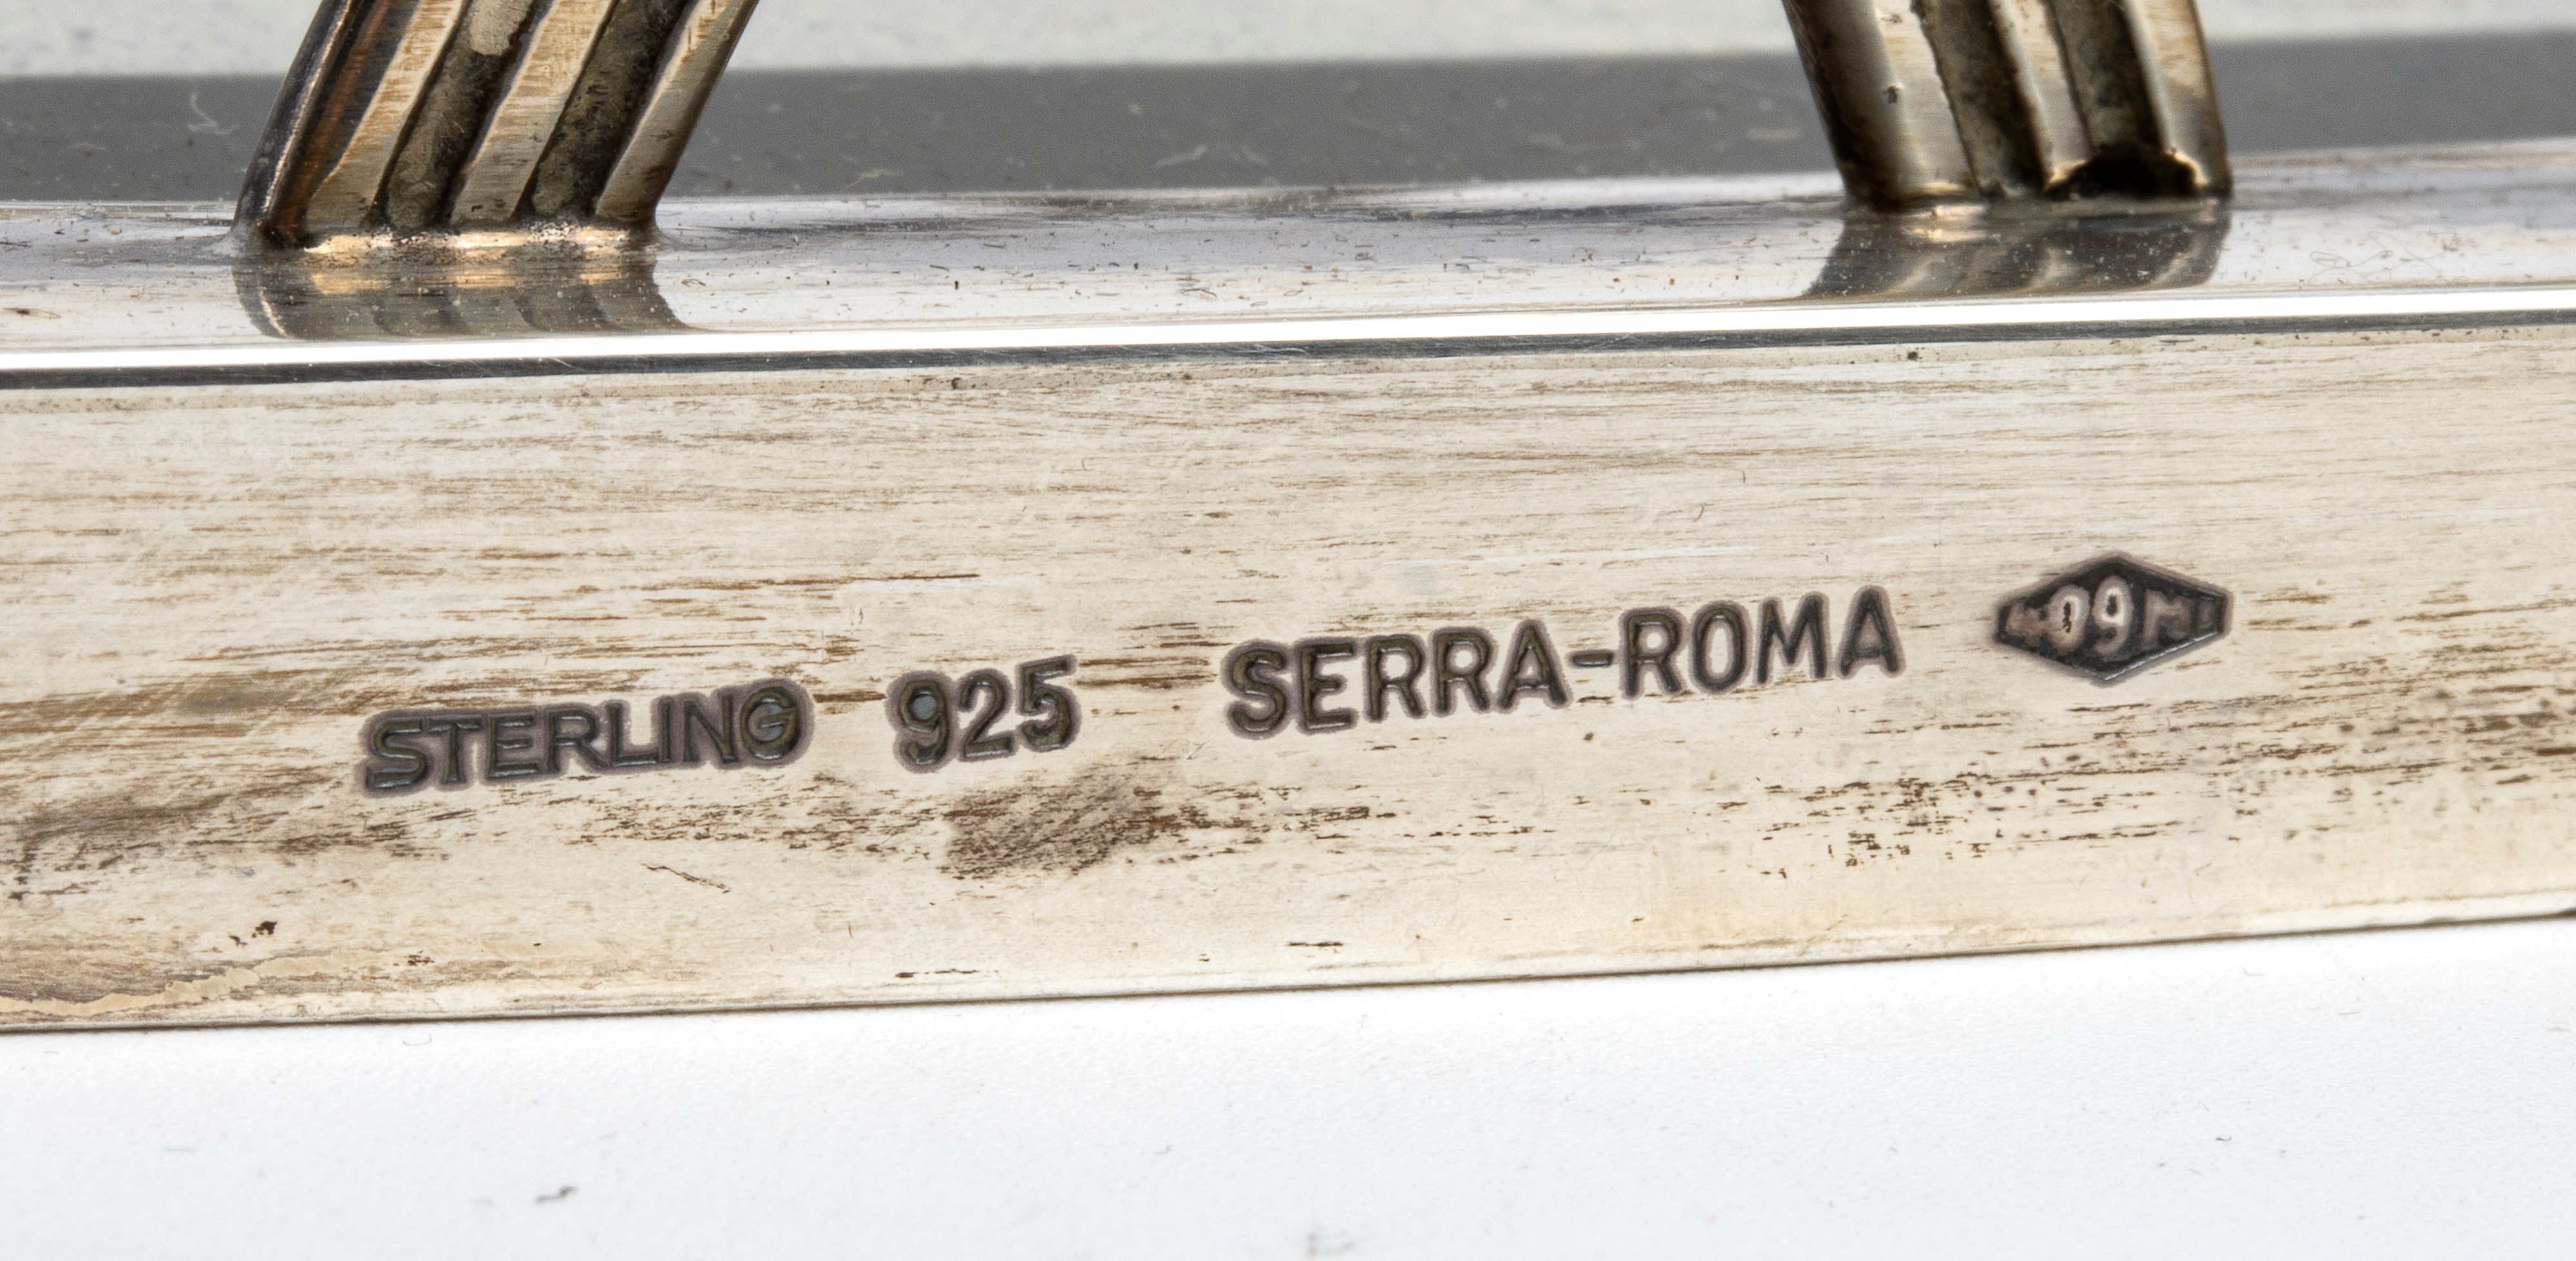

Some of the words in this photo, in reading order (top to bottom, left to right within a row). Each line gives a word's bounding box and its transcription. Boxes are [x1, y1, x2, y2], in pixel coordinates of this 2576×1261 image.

[361, 683, 805, 793] STERLING
[894, 653, 1081, 768] 925
[1224, 585, 1902, 736] SERRA-ROMA
